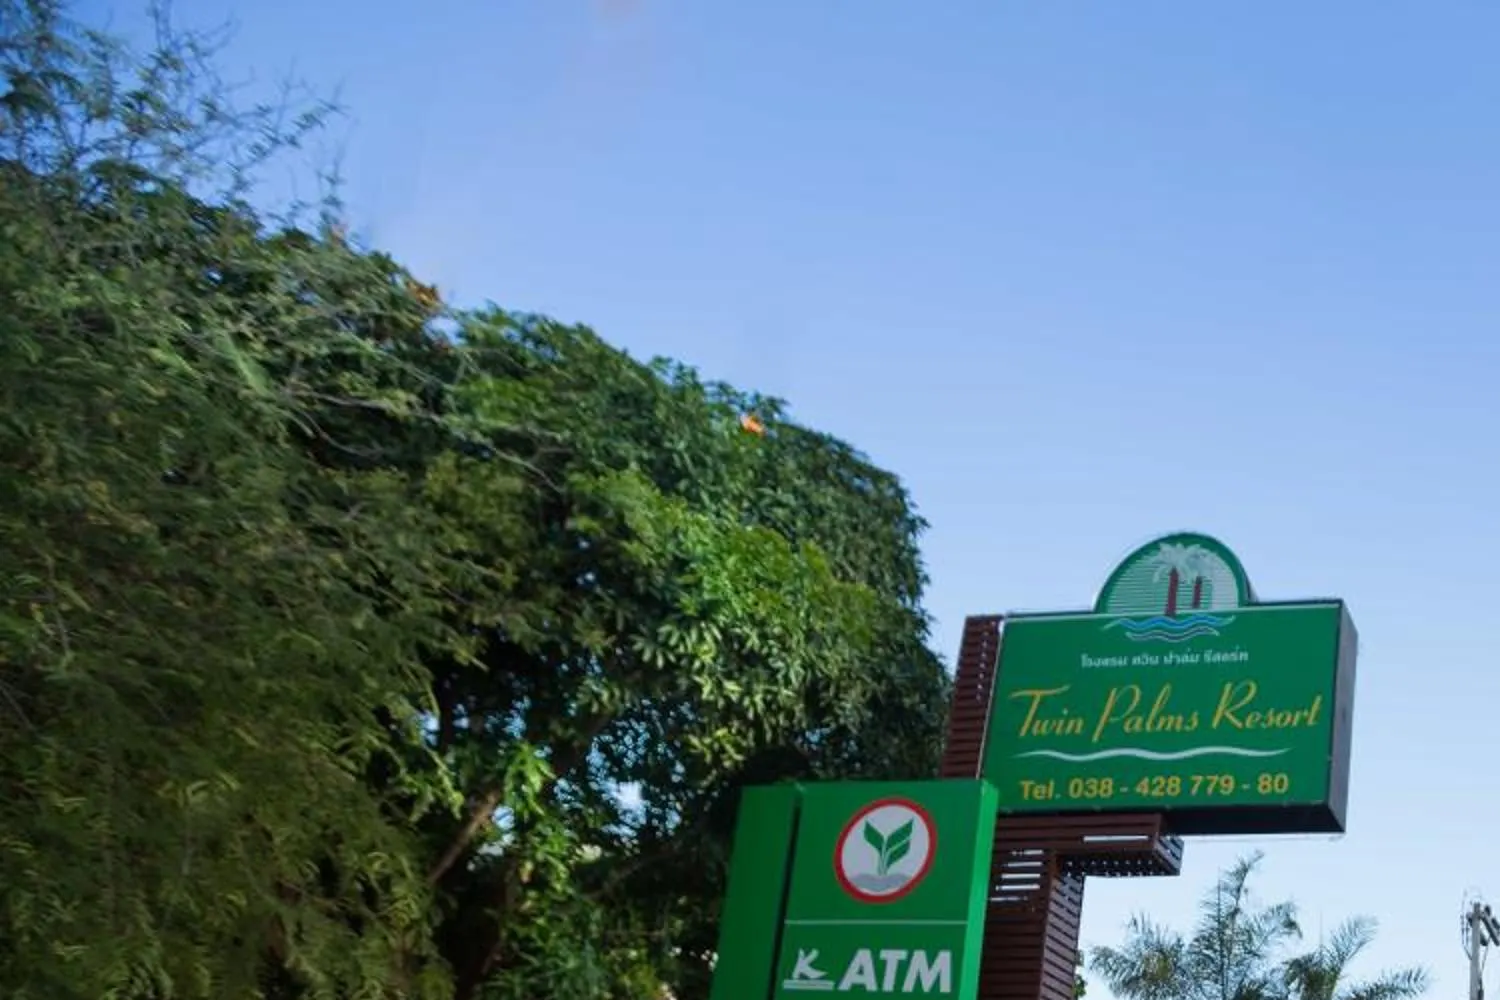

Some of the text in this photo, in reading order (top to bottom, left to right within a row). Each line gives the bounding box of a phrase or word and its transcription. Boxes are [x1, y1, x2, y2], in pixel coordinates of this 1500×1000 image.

[1009, 679, 1323, 743] Twin Palms Resort
[1019, 779, 1061, 800] Tel.
[1068, 777, 1114, 799] 038
[1134, 775, 1182, 797] 428
[1189, 774, 1236, 796] 779
[1256, 772, 1290, 795] 80
[838, 948, 952, 993] ATM
